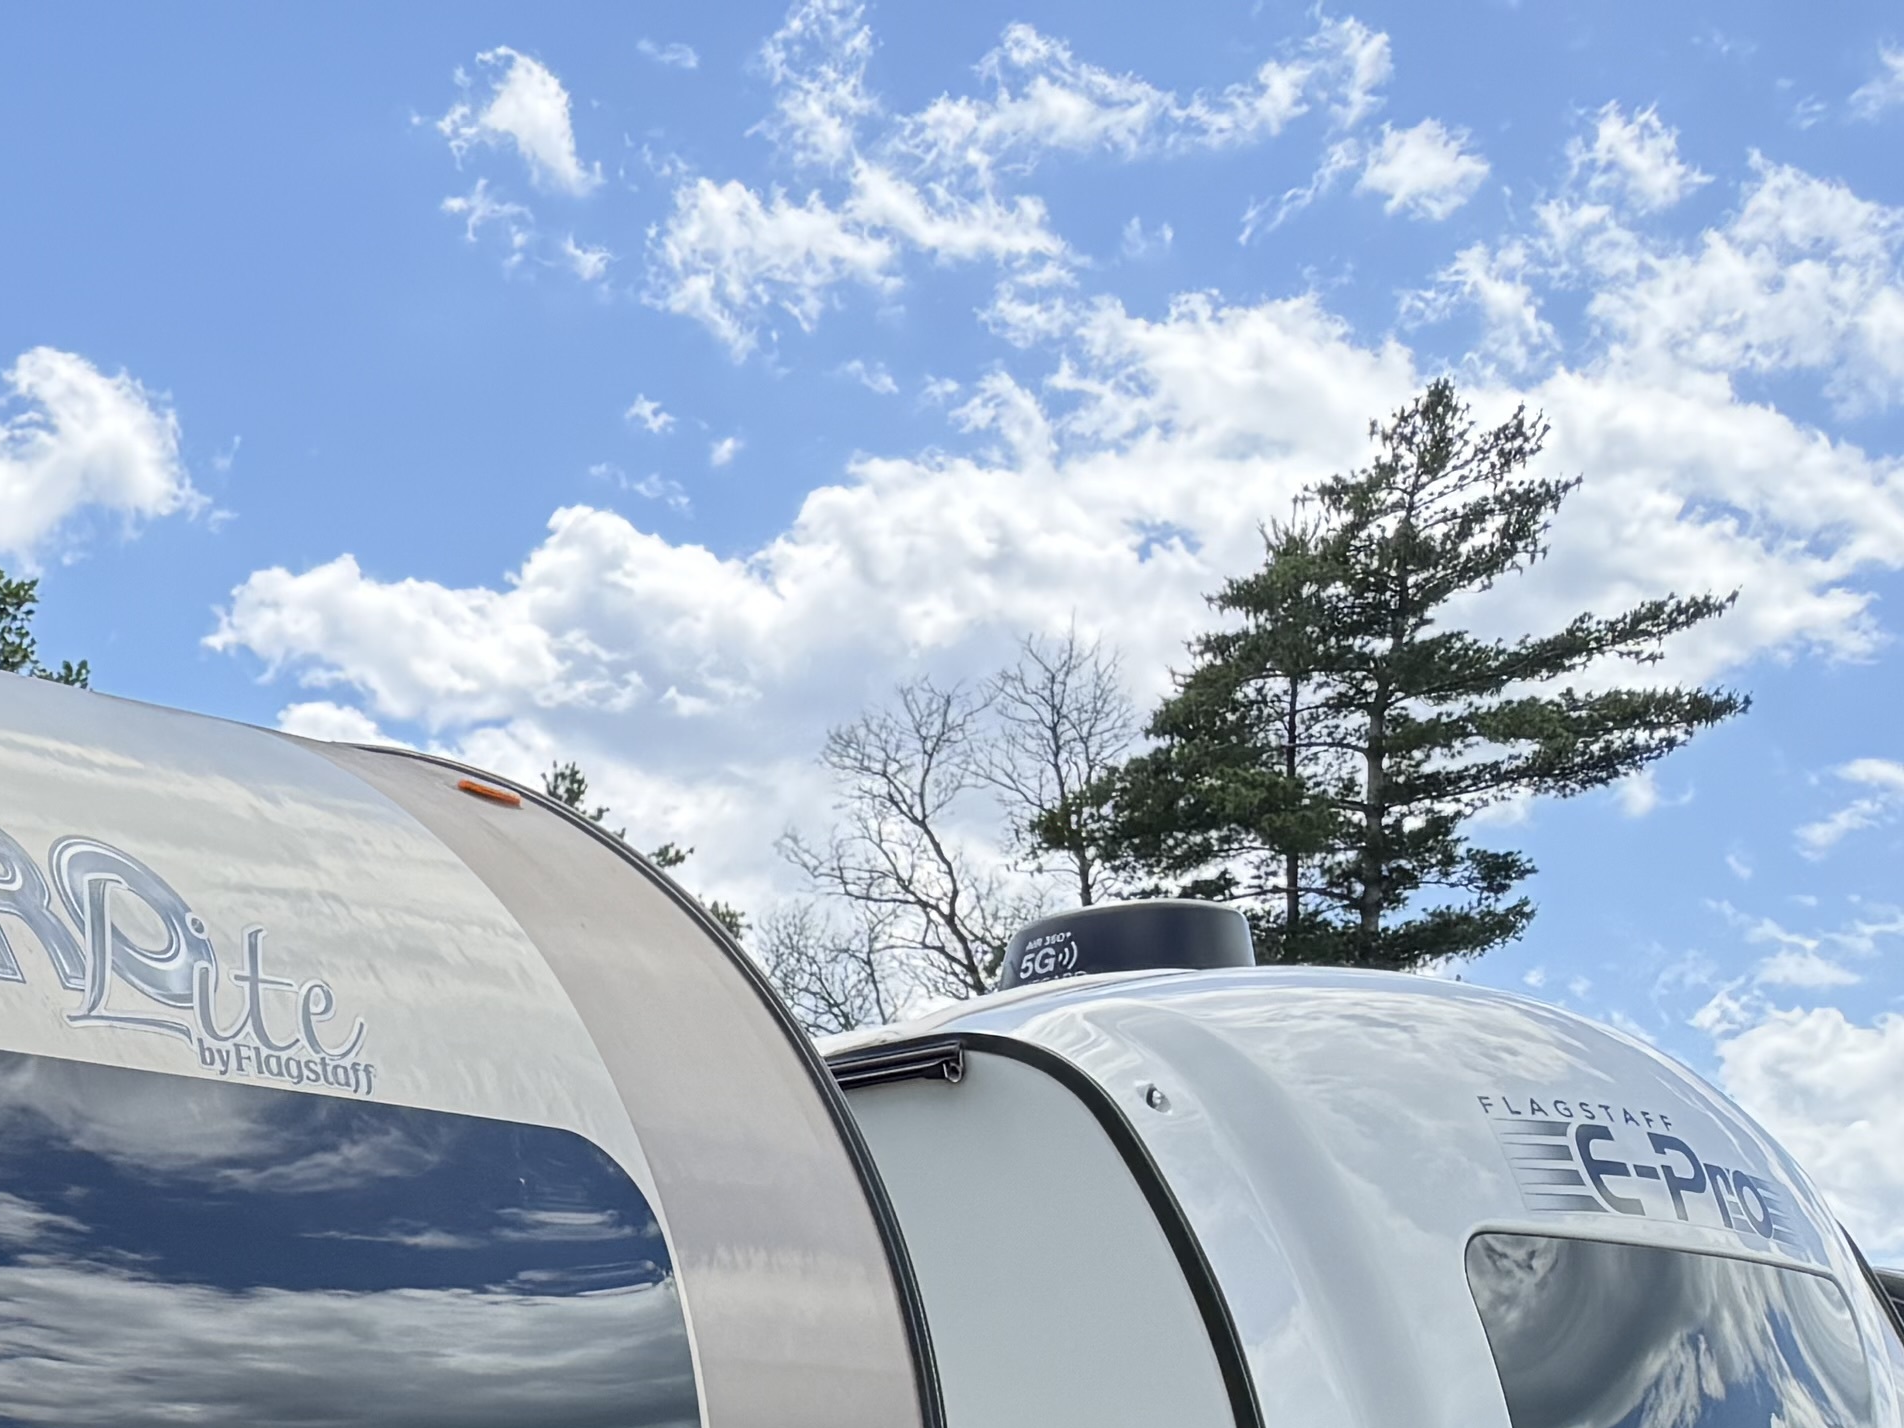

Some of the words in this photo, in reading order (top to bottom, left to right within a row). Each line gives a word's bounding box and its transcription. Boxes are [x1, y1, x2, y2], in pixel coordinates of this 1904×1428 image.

[68, 872, 366, 1060] Lite
[1020, 947, 1056, 979] 5G
[233, 1043, 376, 1096] Flagstaff
[1477, 1095, 1673, 1132] FLAGSTAFF
